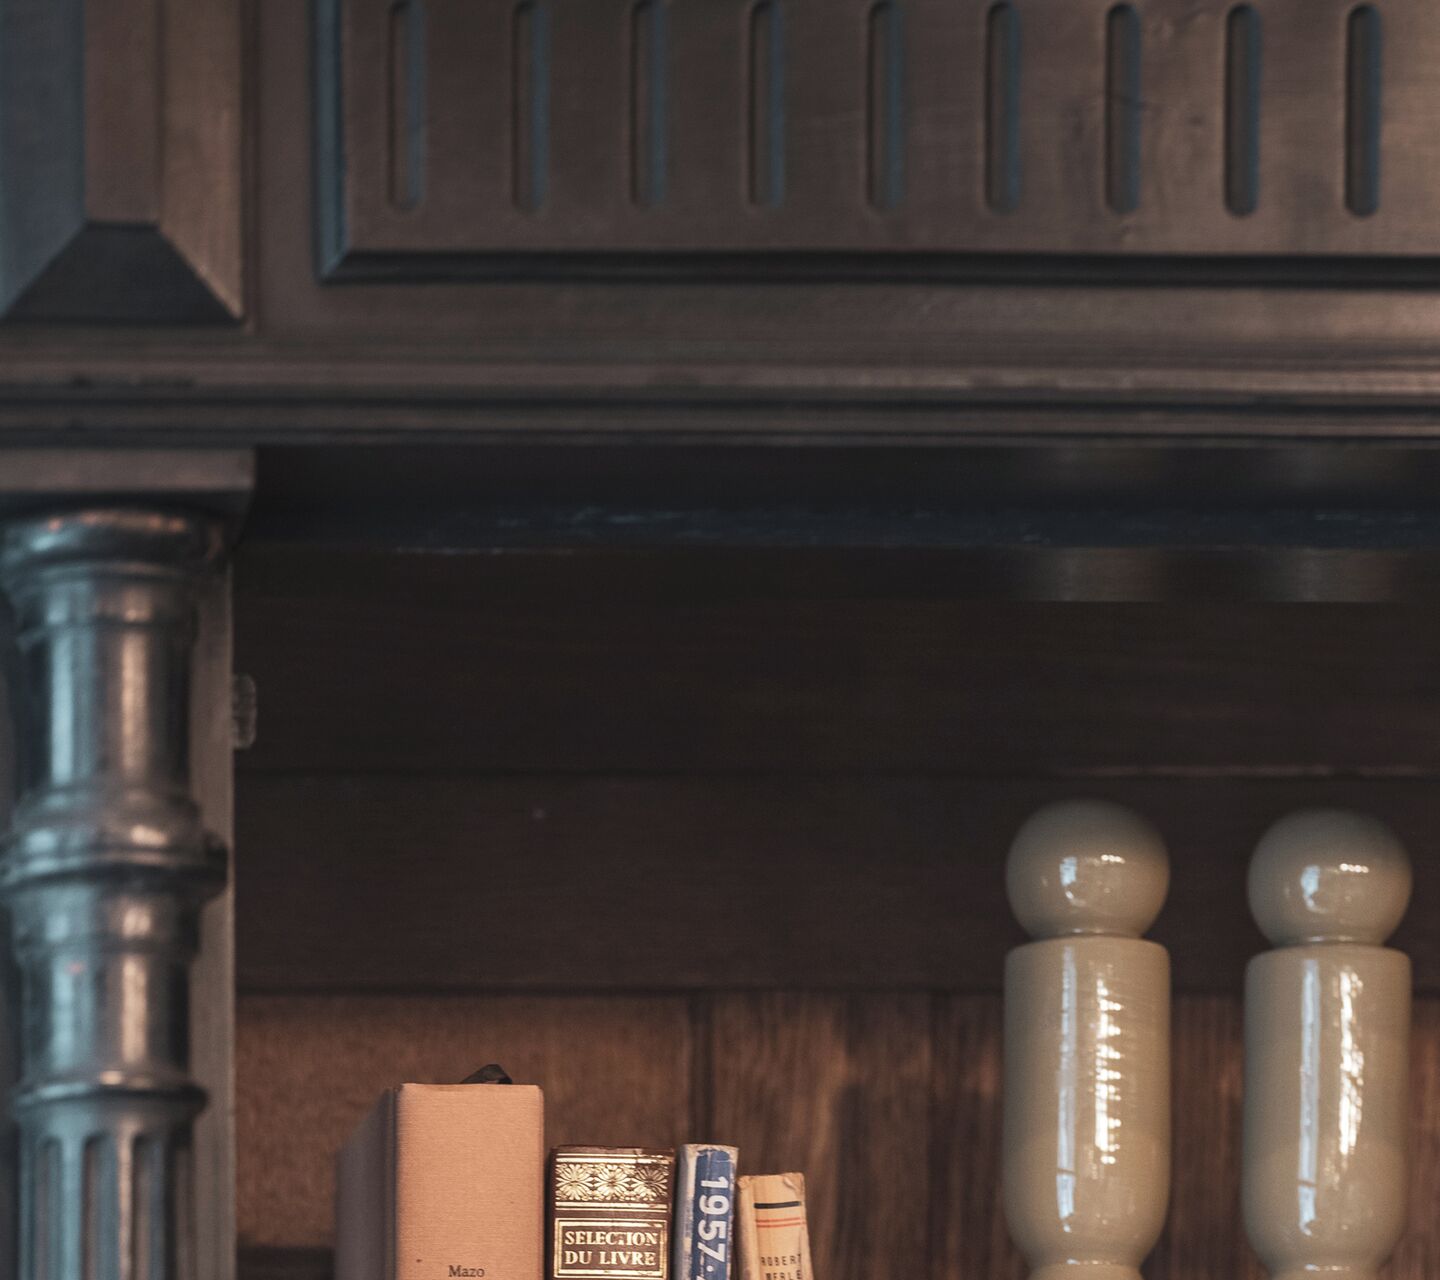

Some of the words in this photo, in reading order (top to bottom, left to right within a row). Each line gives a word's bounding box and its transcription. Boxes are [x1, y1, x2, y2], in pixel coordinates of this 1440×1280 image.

[565, 1251, 592, 1265] DU
[600, 1251, 656, 1266] LIVRE
[761, 1254, 802, 1267] ROBERT
[448, 1265, 485, 1277] Mazo
